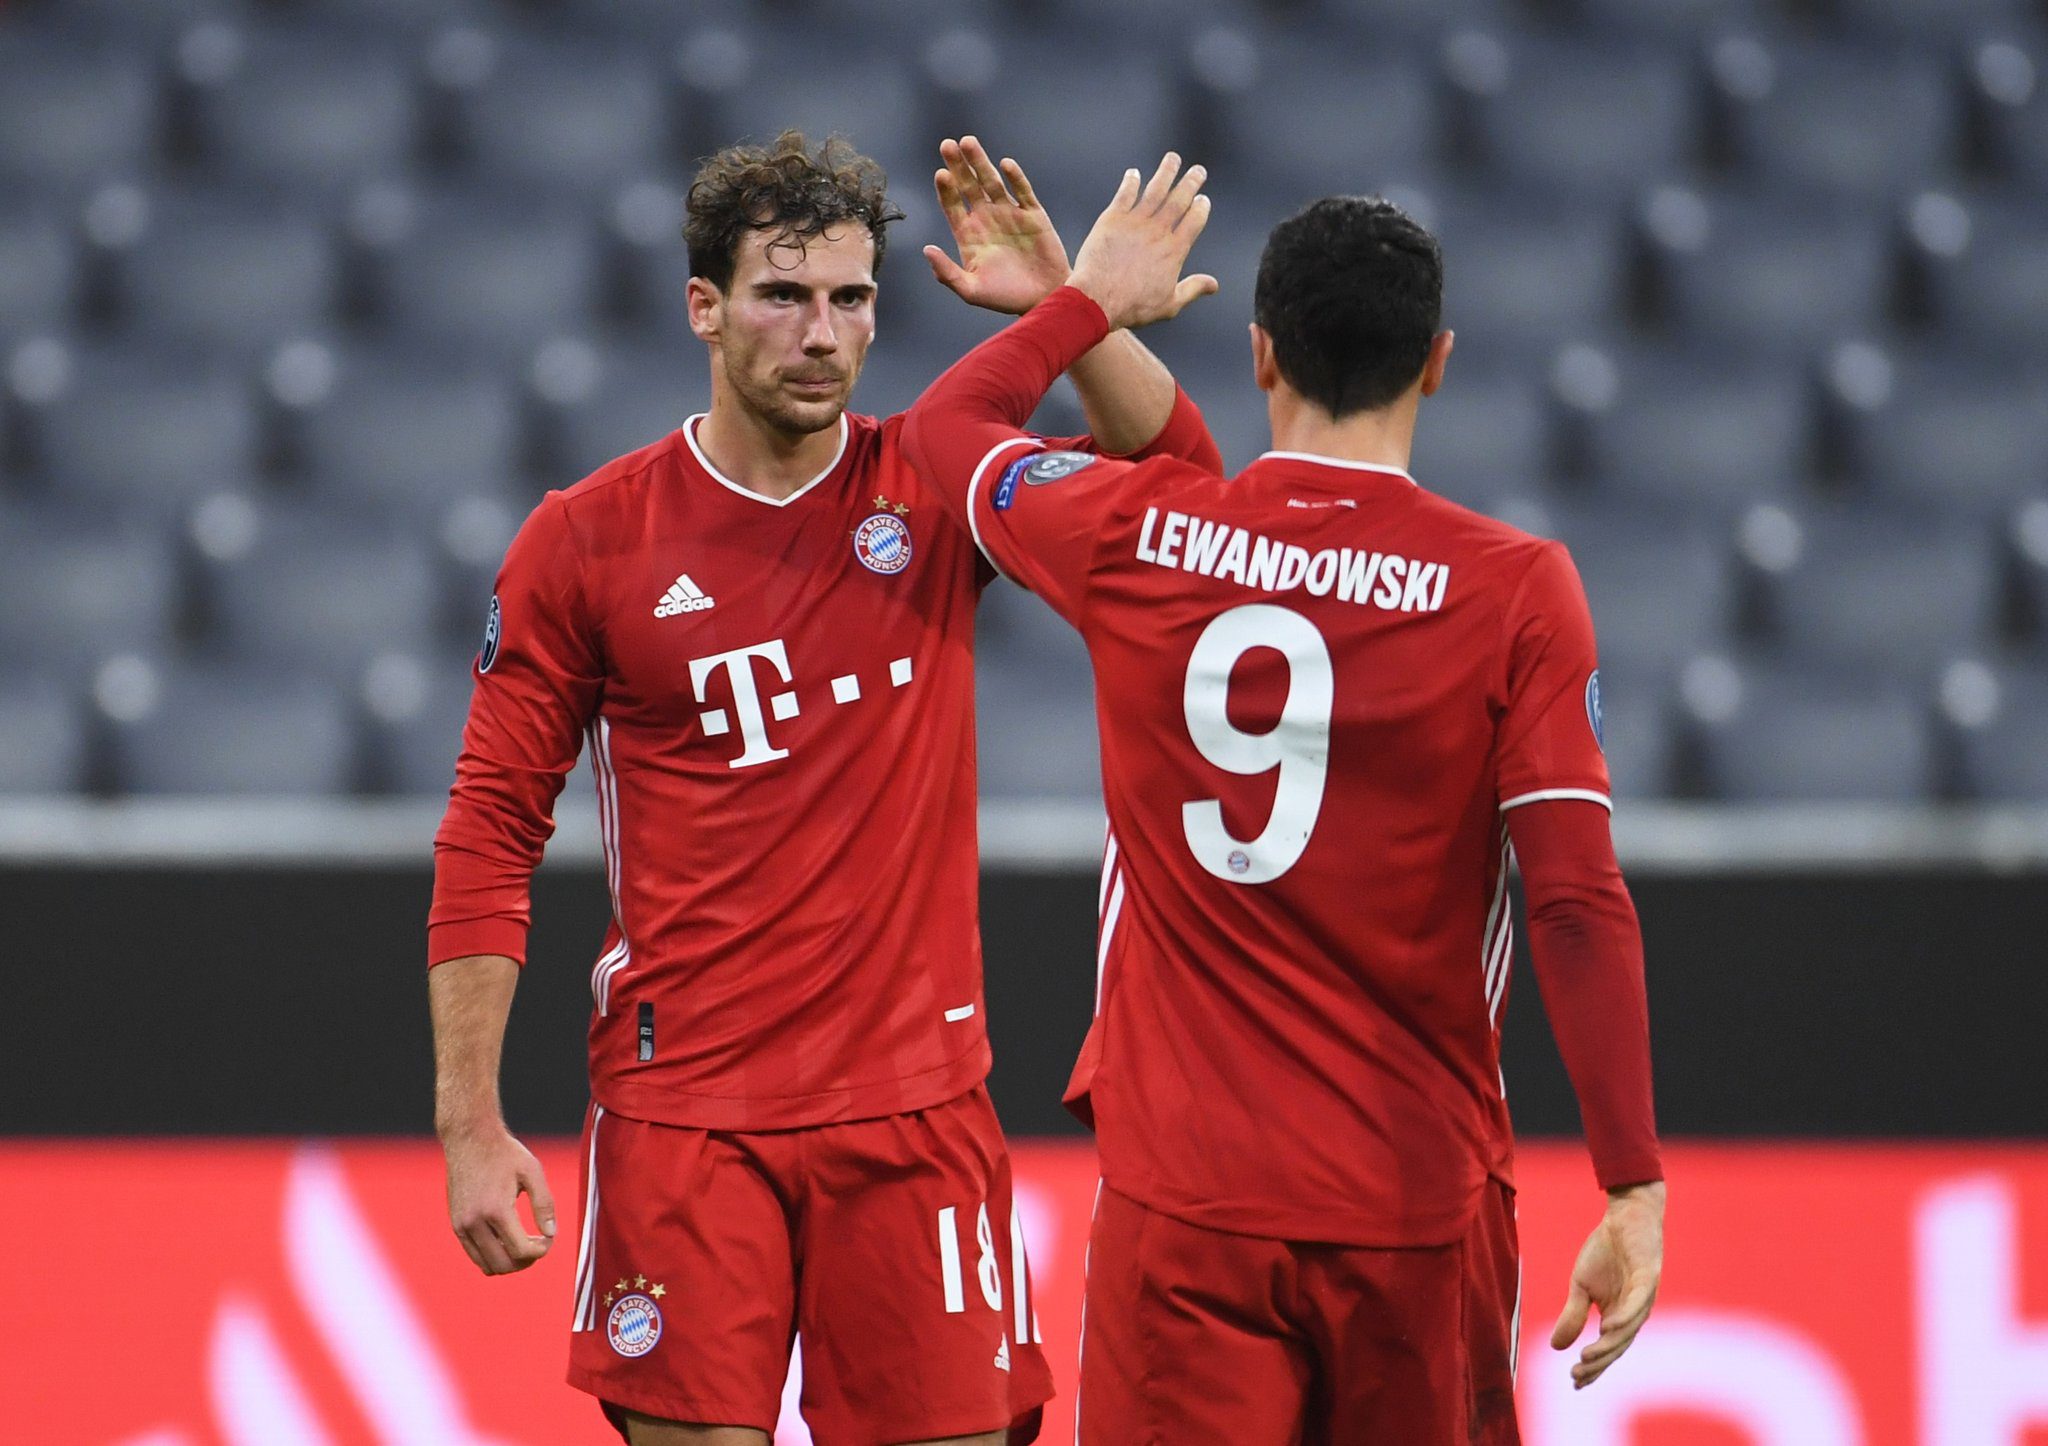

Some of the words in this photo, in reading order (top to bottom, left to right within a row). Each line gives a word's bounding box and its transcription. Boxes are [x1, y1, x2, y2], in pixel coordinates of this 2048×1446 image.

[857, 531, 869, 546] FC
[865, 518, 905, 537] BAYERN
[1135, 507, 1449, 612] LEWANDOWSKI
[653, 596, 716, 619] adidas
[1182, 603, 1334, 884] 9
[938, 1201, 1003, 1313] 18
[611, 1309, 622, 1325] FC
[621, 1299, 656, 1319] BAYERN
